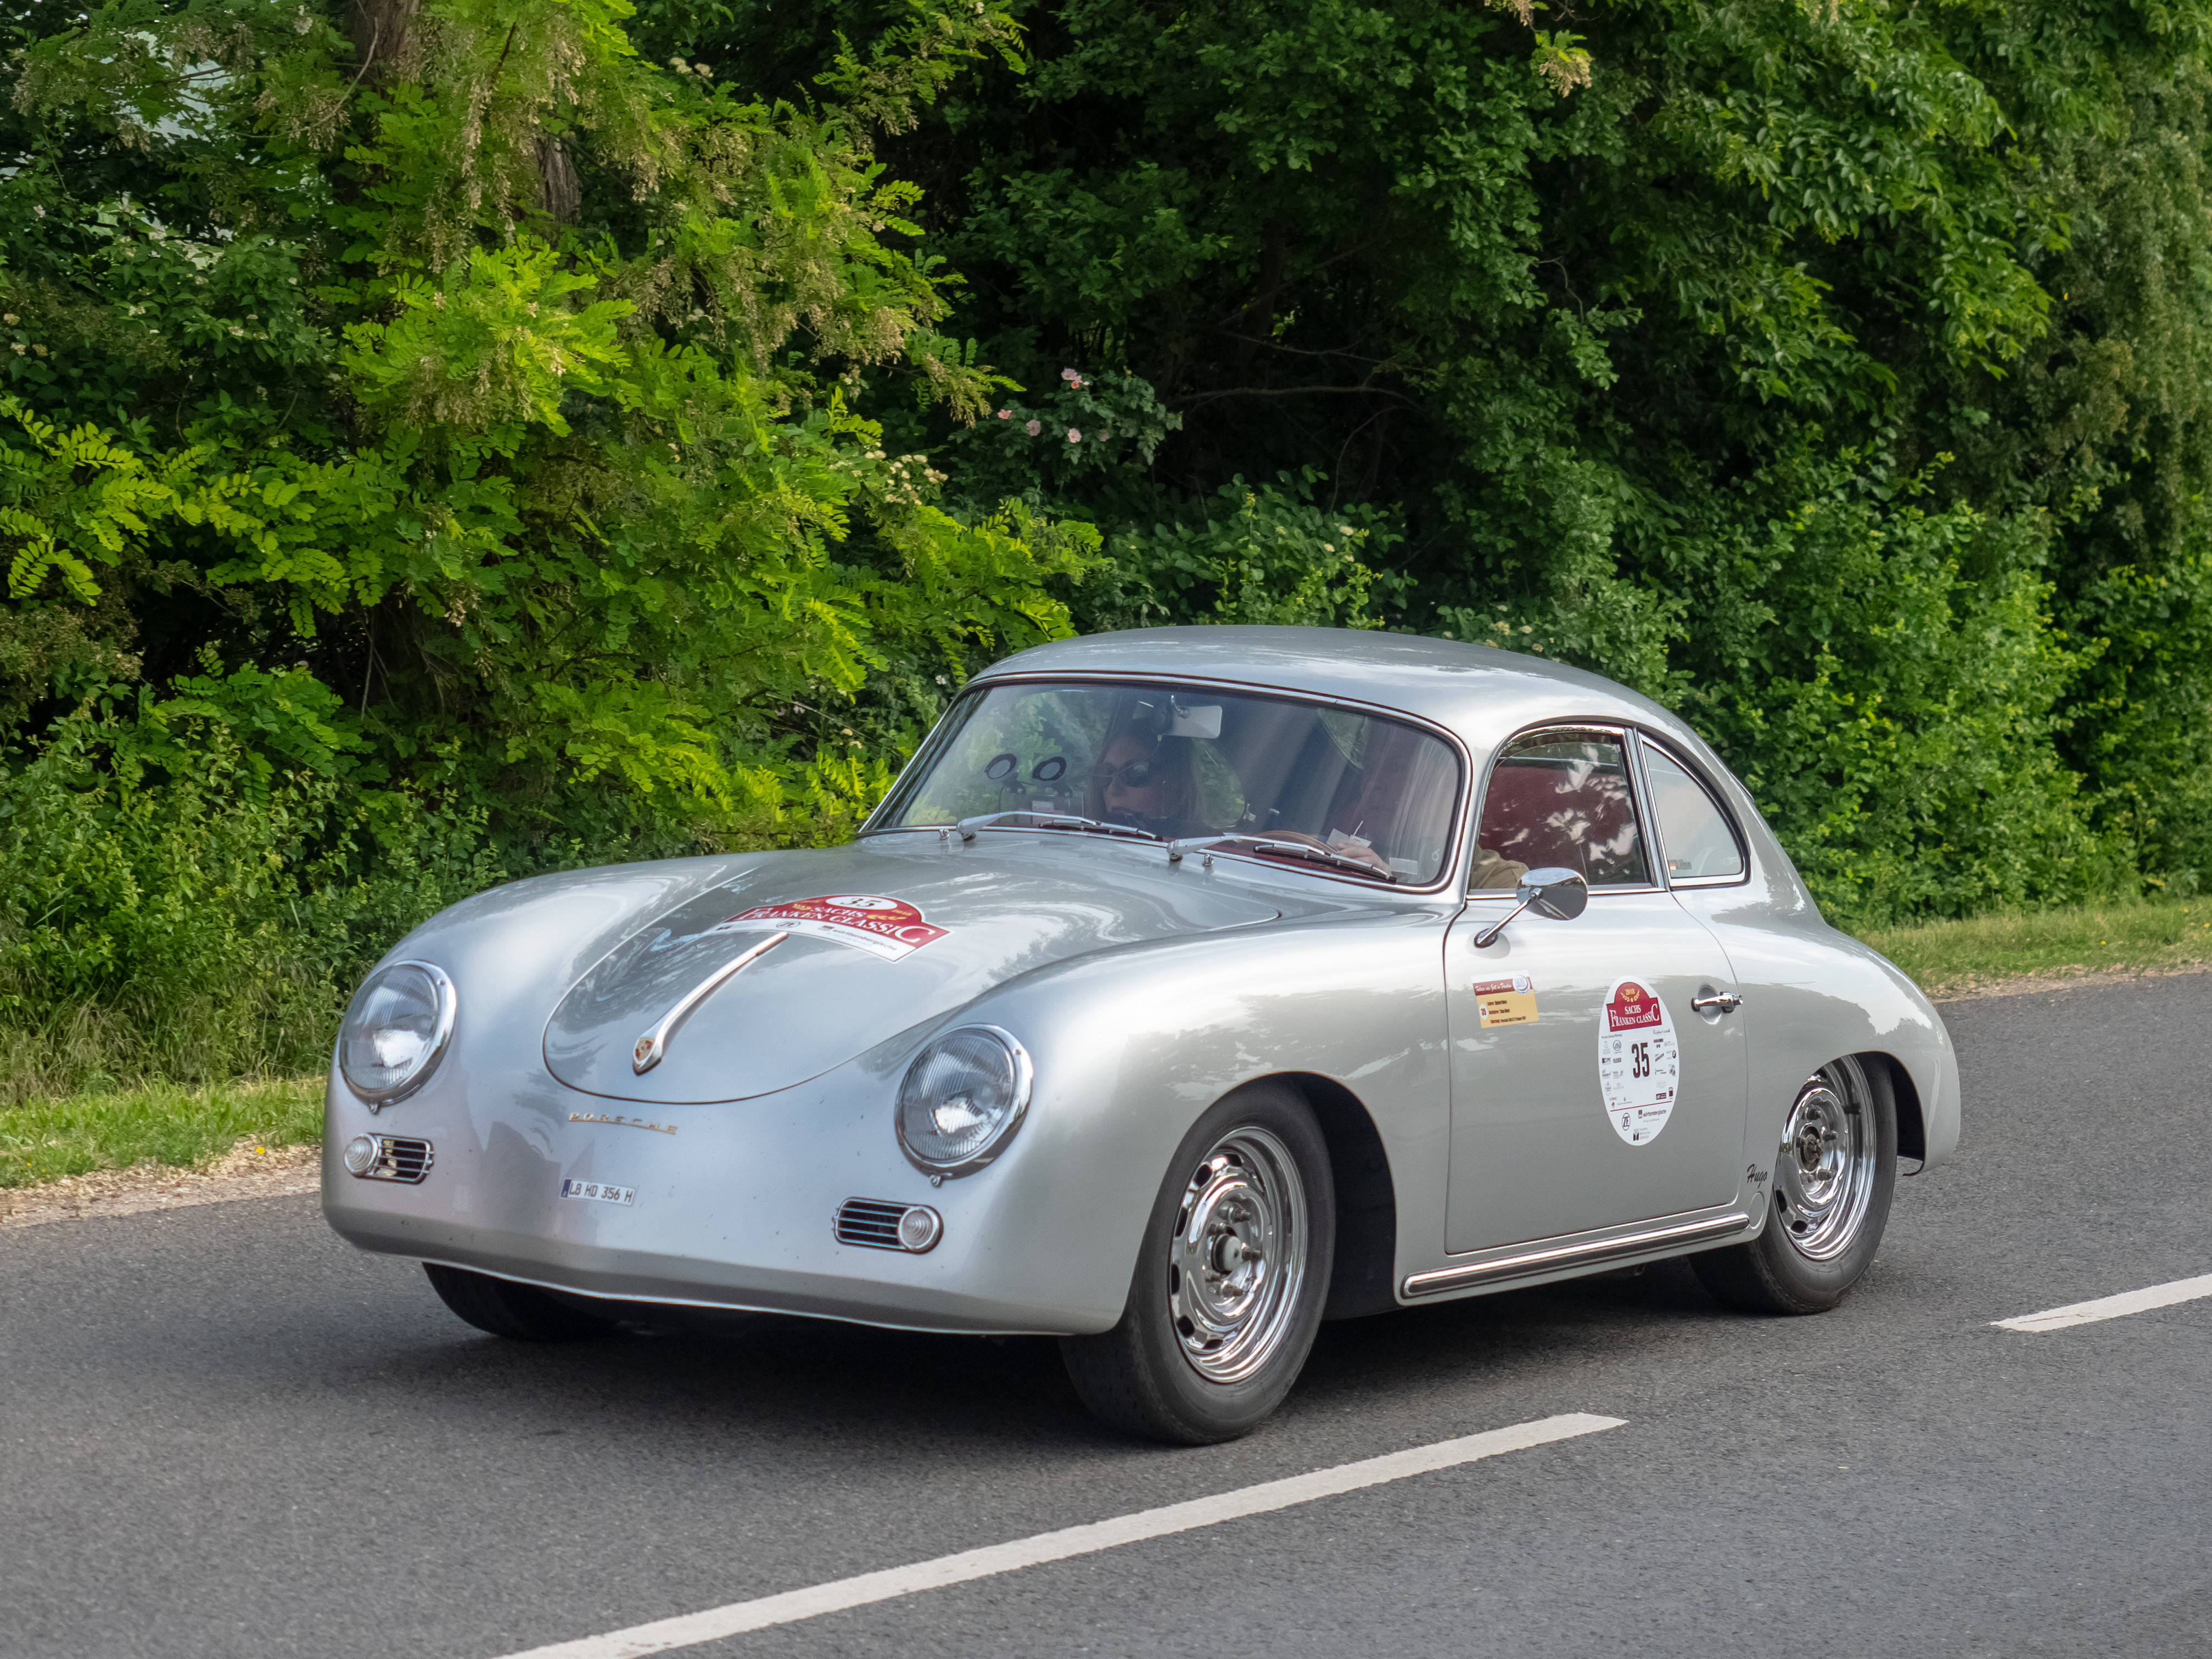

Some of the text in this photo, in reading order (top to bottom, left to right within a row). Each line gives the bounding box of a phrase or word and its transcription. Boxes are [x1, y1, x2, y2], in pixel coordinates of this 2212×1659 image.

[814, 907, 867, 917] SACHS
[840, 898, 882, 907] 35
[732, 907, 830, 921] FRANKEN
[829, 915, 936, 943] CLASSIC
[1609, 1004, 1660, 1027] FRANKEN CLASSIC
[1625, 1005, 1642, 1015] SACHS
[1631, 1041, 1650, 1079] 35
[569, 1112, 679, 1134] PORSCHE
[1747, 1163, 1767, 1189] Hugo
[569, 1182, 582, 1195] LB
[585, 1184, 598, 1197] HD
[601, 1186, 620, 1201] 356
[624, 1190, 633, 1203] H
